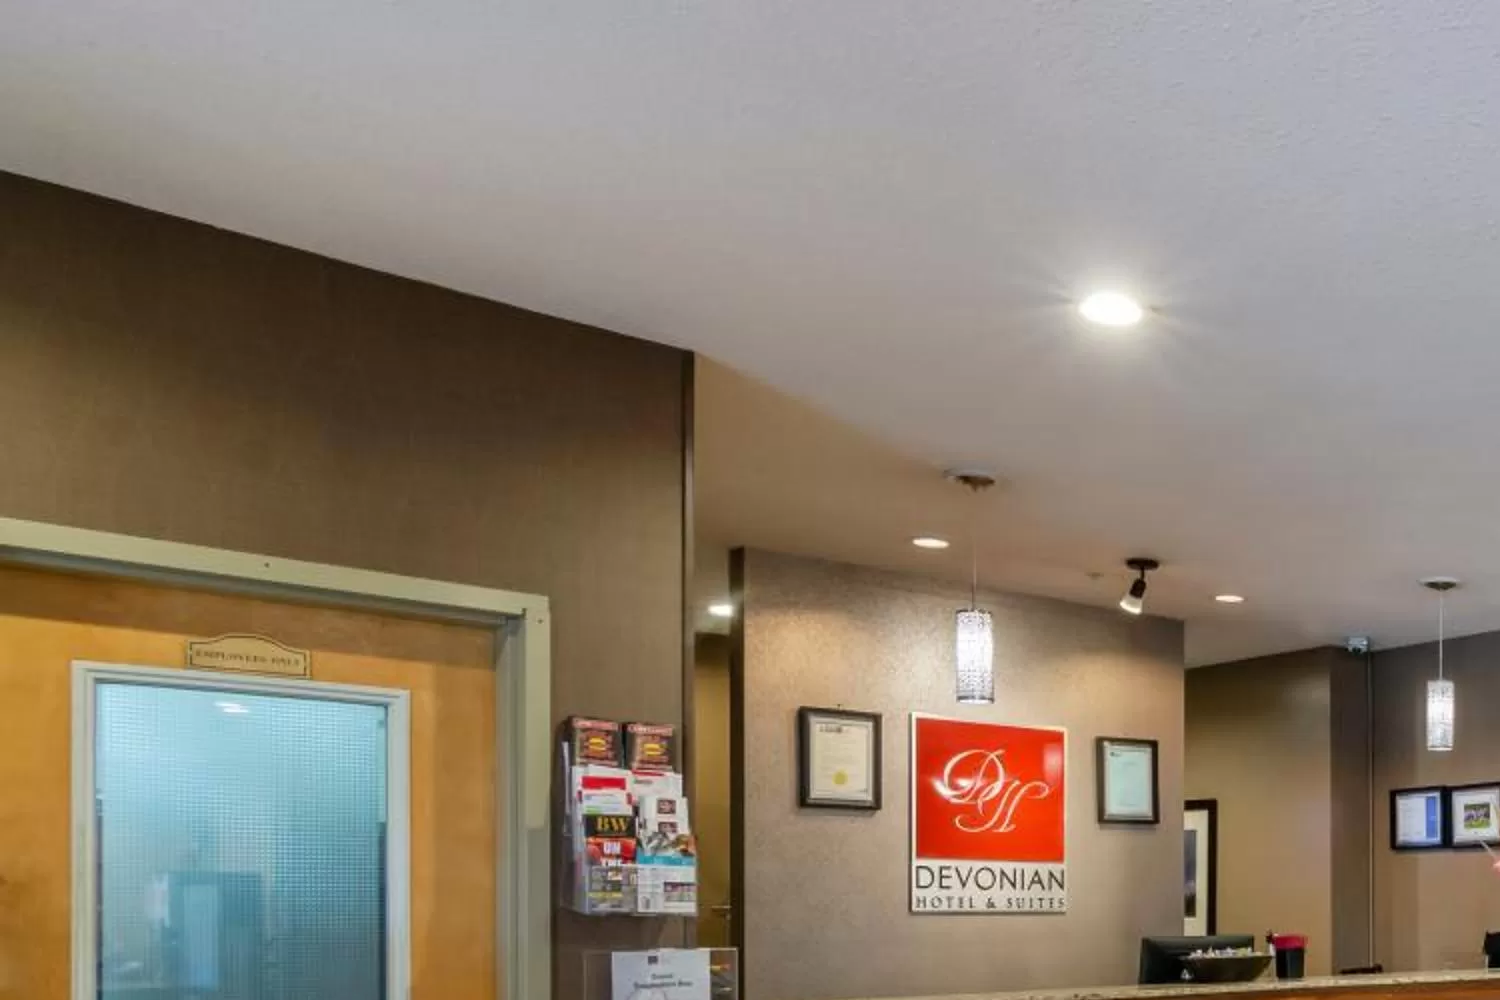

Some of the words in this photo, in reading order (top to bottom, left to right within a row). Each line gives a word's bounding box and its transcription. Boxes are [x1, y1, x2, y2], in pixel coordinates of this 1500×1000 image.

[915, 865, 1066, 892] DEVONIAN
[915, 895, 976, 909] HOTEL
[985, 897, 998, 909] &
[1006, 896, 1066, 910] SUITES
